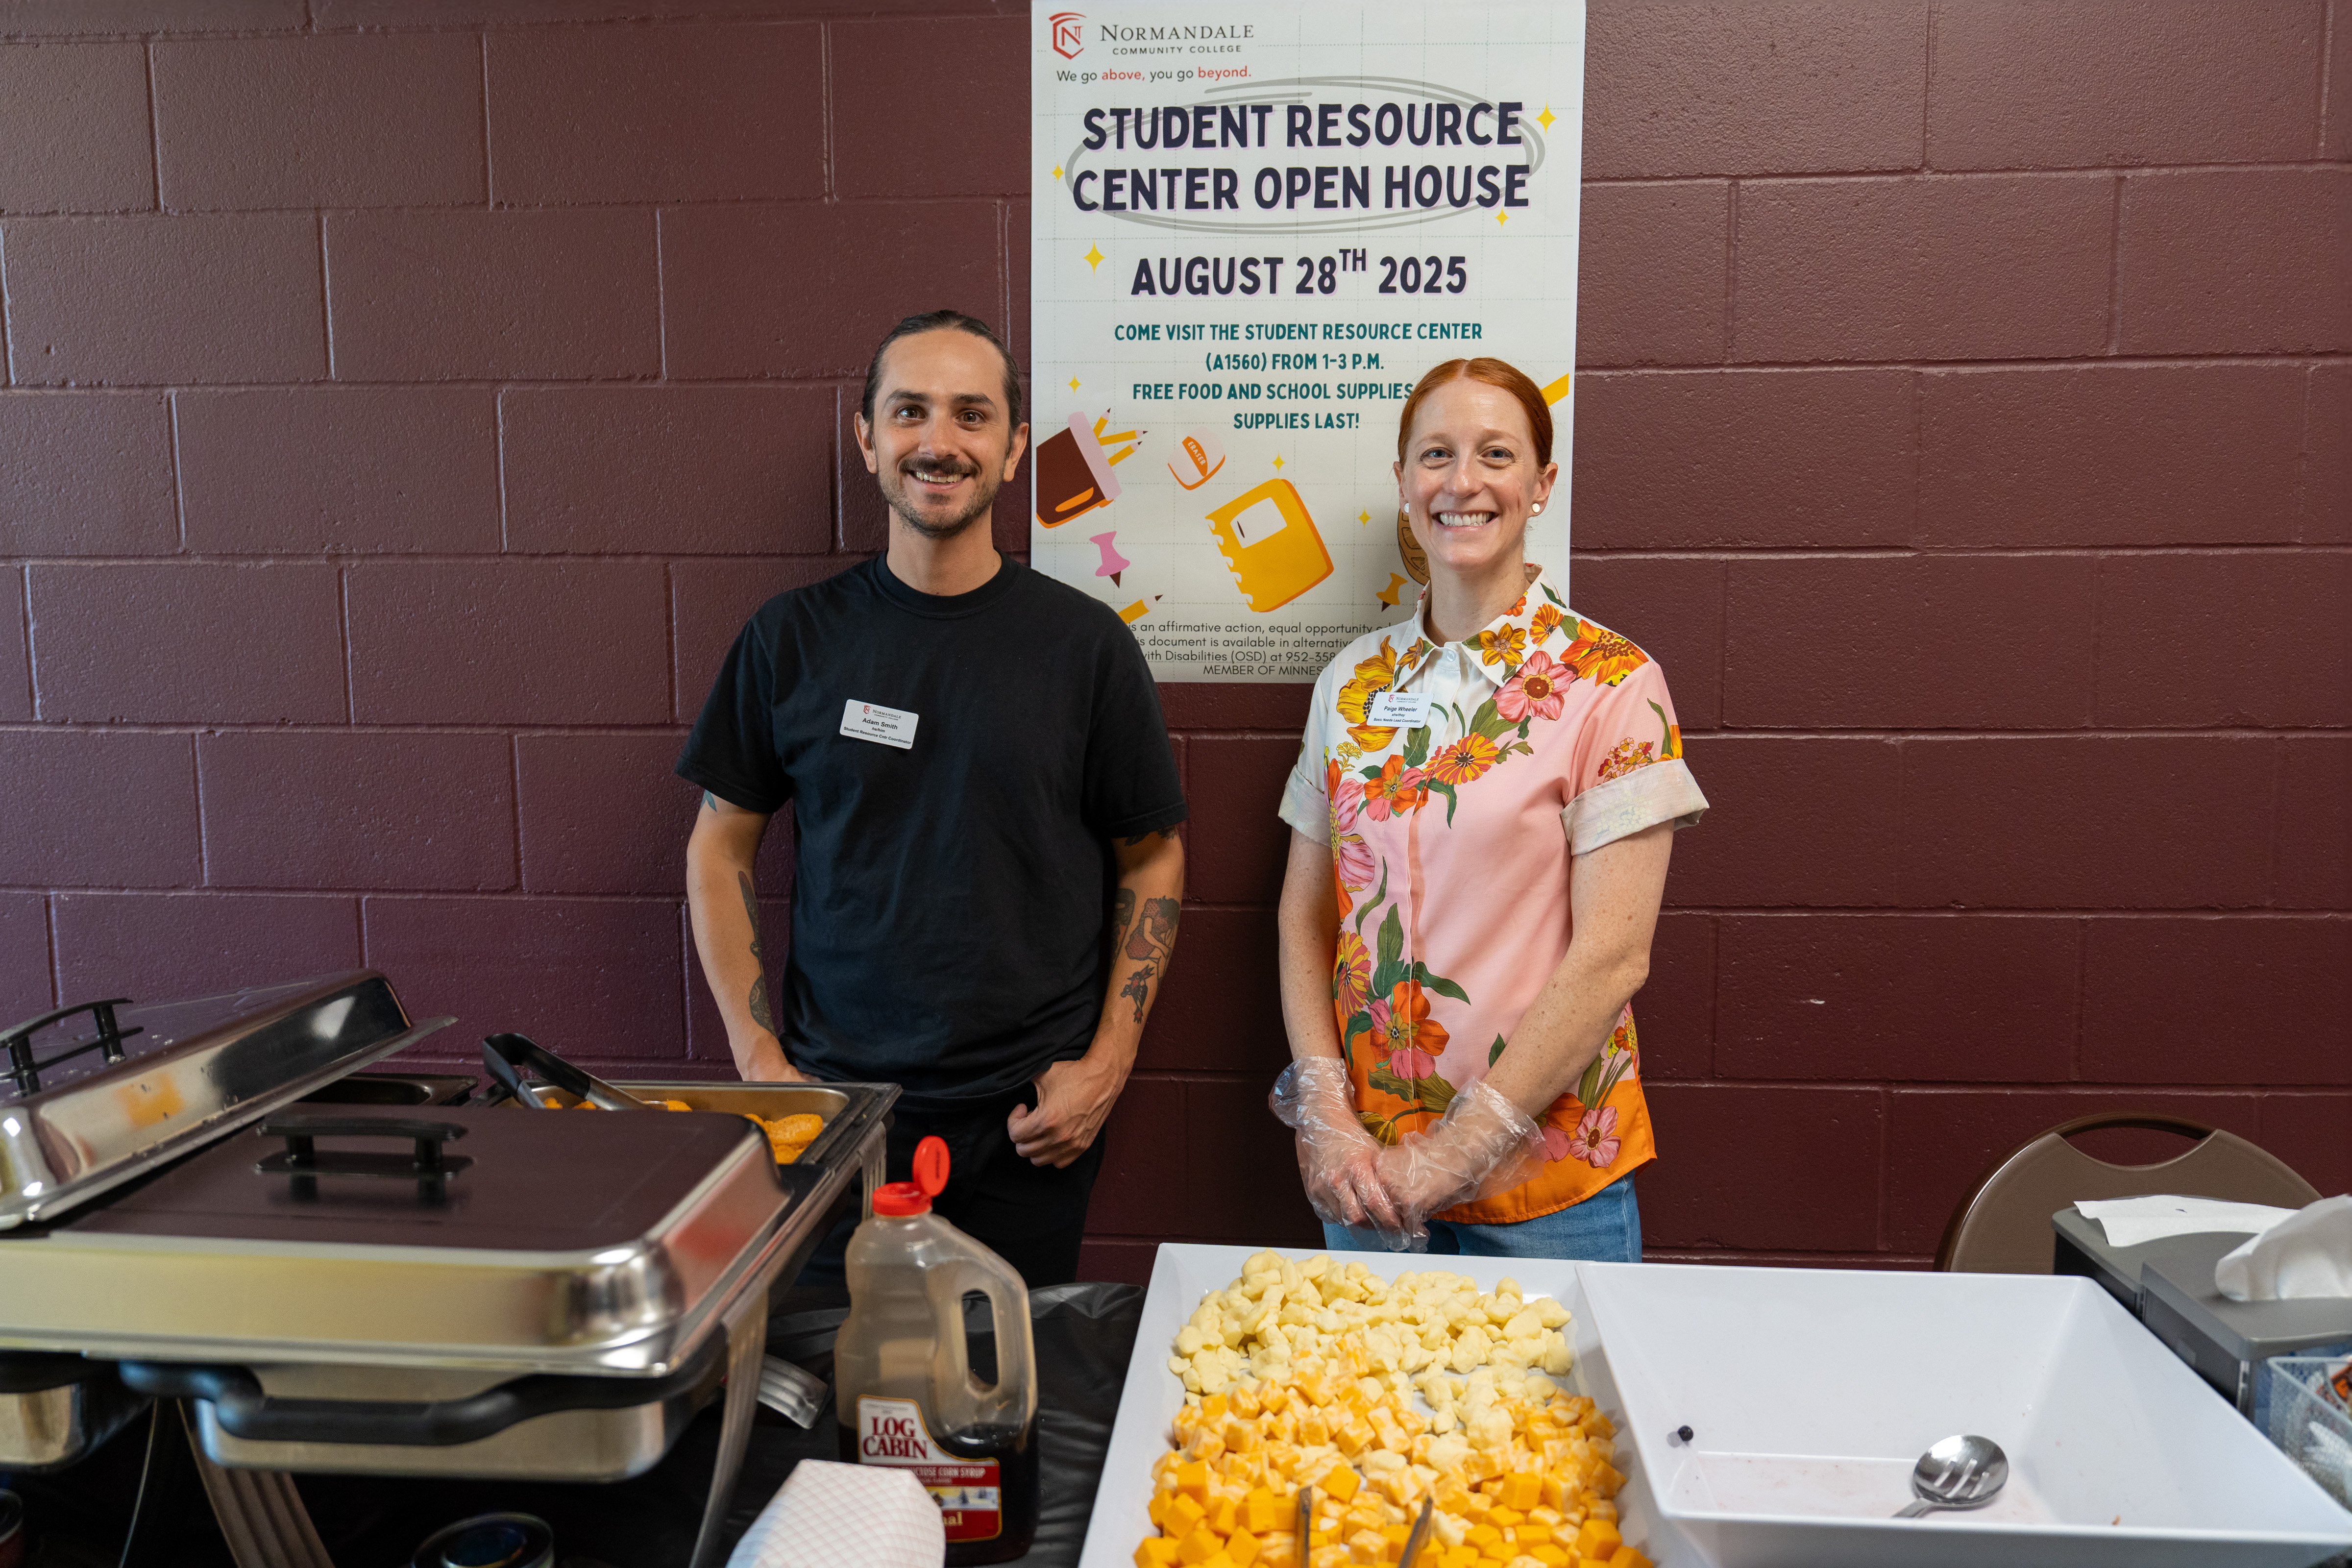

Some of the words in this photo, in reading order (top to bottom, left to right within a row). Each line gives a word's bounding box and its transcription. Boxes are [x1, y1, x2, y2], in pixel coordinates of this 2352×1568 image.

[1100, 24, 1254, 41] NORMANDALE
[1112, 47, 1183, 55] COMMUNITY
[1189, 45, 1242, 53] COLLEGE
[1056, 70, 1077, 81] We
[1081, 72, 1097, 84] go
[1102, 69, 1145, 81] above,
[1150, 71, 1172, 84] you
[1177, 70, 1194, 83] go
[1198, 65, 1251, 81] beyond.
[1082, 105, 1274, 150] STUDENT
[1287, 102, 1523, 147] RESOURCE
[1073, 167, 1240, 212] CENTER
[1254, 166, 1370, 210] OPEN
[1384, 164, 1530, 208] HOUSE
[1131, 257, 1284, 295] AUGUST
[1379, 255, 1467, 294] 2025
[1114, 324, 1161, 341] COME
[1166, 324, 1205, 341] VISIT
[1210, 324, 1240, 341] THE
[1245, 323, 1318, 340] STUDENT
[1323, 323, 1413, 340] RESOURCE
[1417, 323, 1482, 339] CENTER
[1206, 352, 1267, 372] (A1560)
[1273, 353, 1317, 370] FROM
[1323, 353, 1347, 369] 1-3
[1352, 353, 1384, 369] P.M.
[1133, 383, 1174, 400] FREE
[1179, 383, 1223, 400] FOOD
[1226, 383, 1261, 399] AND
[1267, 383, 1331, 399] SCHOOL
[1337, 382, 1413, 399] SUPPLIES
[1233, 413, 1310, 429] SUPPLIES
[1315, 413, 1359, 429] LAST!
[1187, 441, 1206, 466] ERASER
[1158, 621, 1221, 632] affirmative
[1225, 623, 1265, 634] action,
[1269, 622, 1301, 636] equal
[1305, 624, 1372, 636] opportunity
[1149, 635, 1206, 646] document
[1210, 637, 1219, 647] is
[1223, 636, 1275, 647] available
[1280, 638, 1289, 647] in
[1293, 637, 1353, 648] alternativ
[1166, 650, 1227, 661] Disabilities
[1231, 650, 1267, 663] (OSD)
[1270, 652, 1282, 662] at
[1203, 665, 1254, 675] MEMBER
[1258, 665, 1275, 675] OF
[872, 709, 902, 719] NORMANDALE
[888, 736, 911, 744] Coordinator
[871, 1416, 916, 1438] LOG
[863, 1436, 927, 1459] CABIN
[938, 1467, 959, 1477] CORN
[960, 1467, 986, 1478] SYRUP
